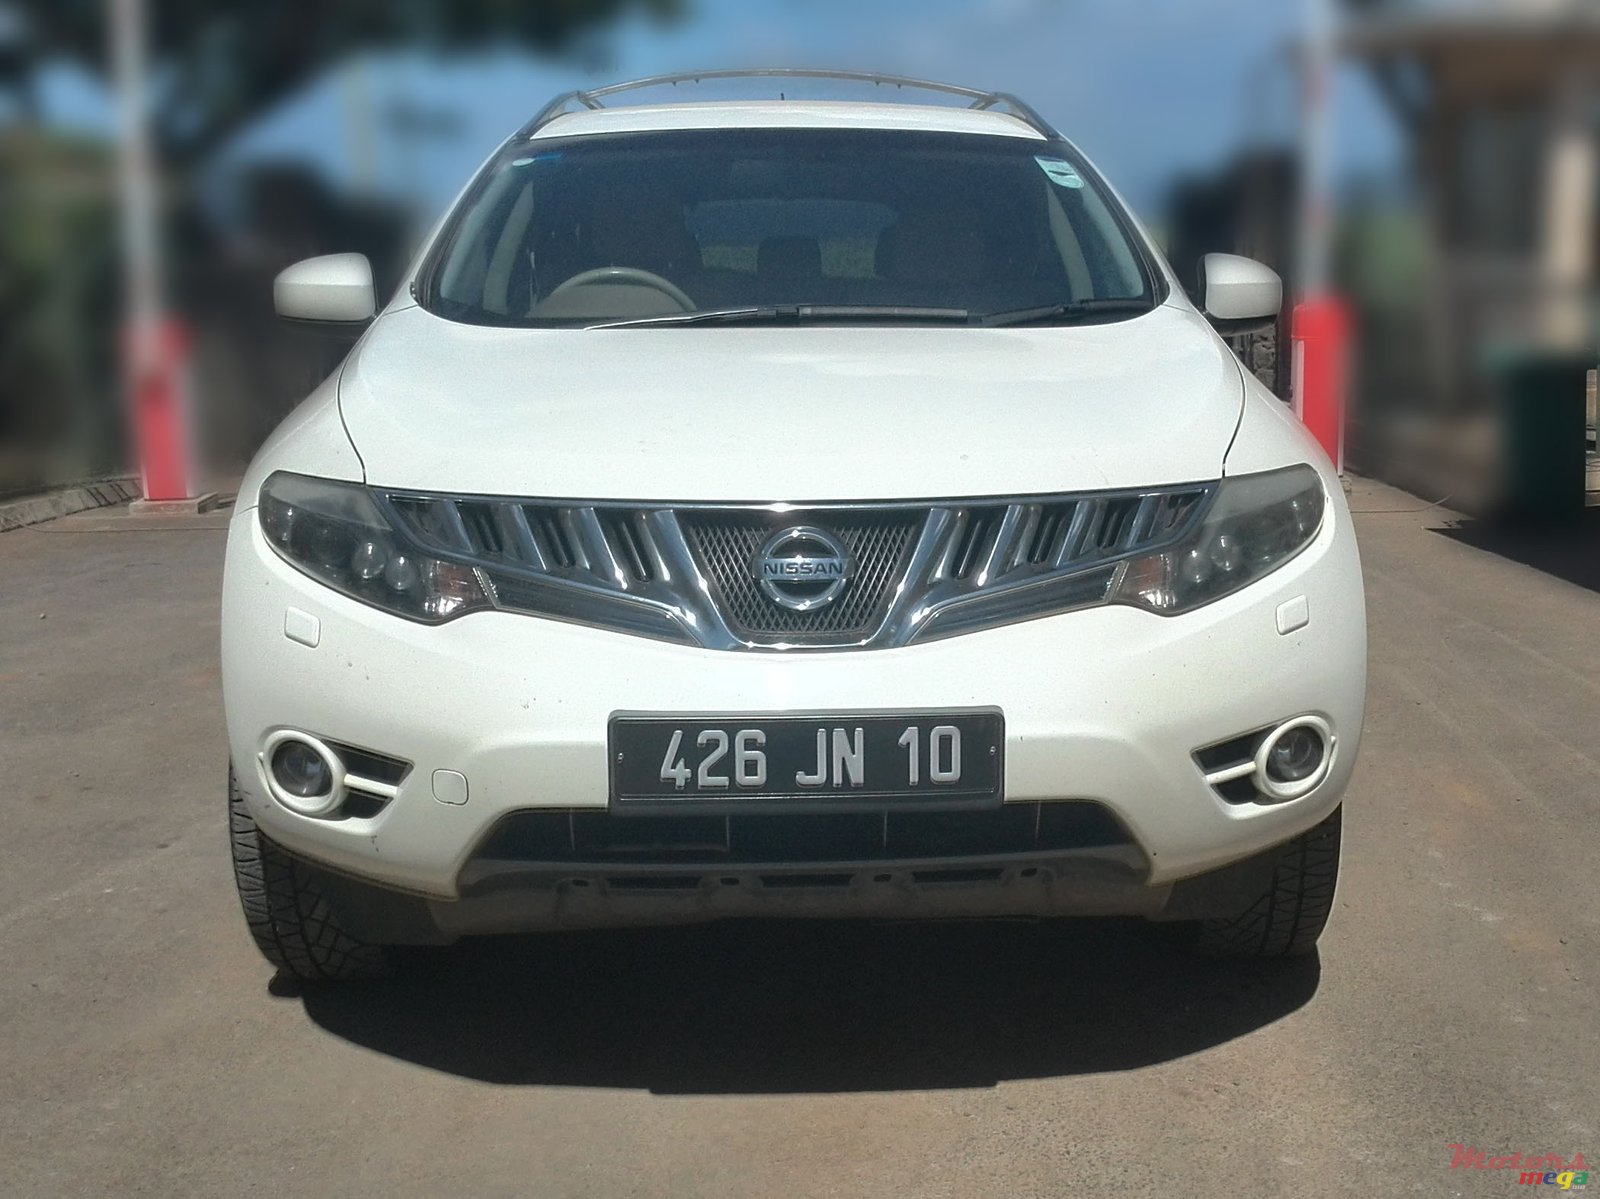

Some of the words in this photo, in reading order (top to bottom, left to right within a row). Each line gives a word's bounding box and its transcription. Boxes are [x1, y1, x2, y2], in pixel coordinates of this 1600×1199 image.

[764, 562, 842, 575] NISSAN
[660, 729, 766, 789] 426
[795, 727, 864, 787] JN
[898, 725, 962, 787] 10
